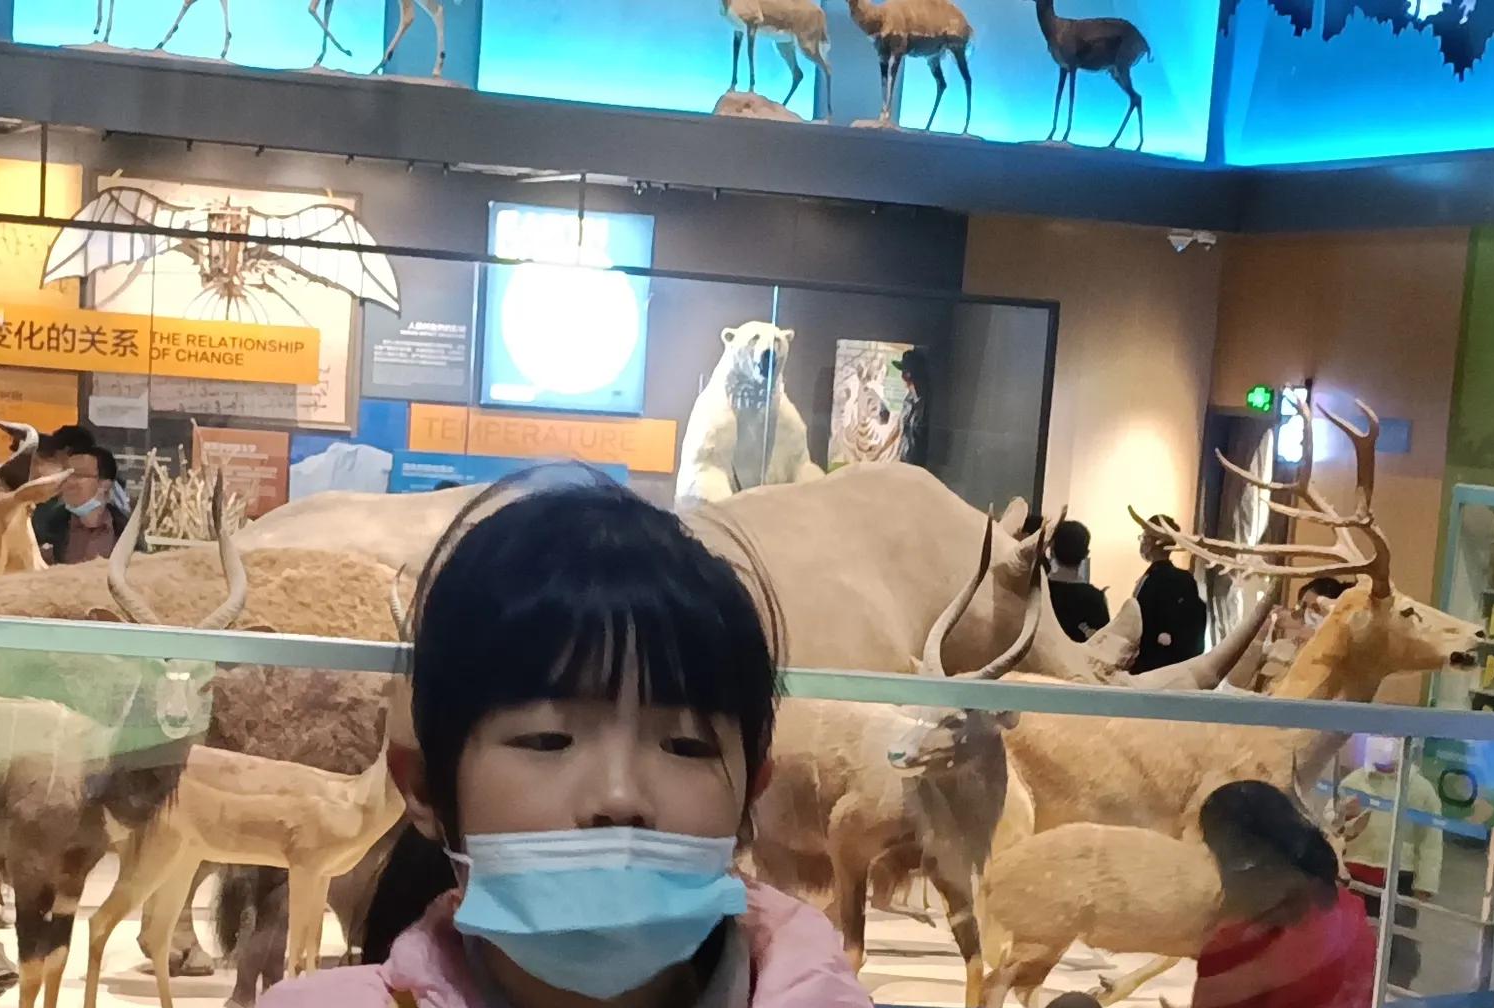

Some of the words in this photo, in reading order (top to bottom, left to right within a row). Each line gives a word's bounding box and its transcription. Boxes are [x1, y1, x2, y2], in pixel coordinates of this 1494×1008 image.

[150, 331, 181, 348] THE
[186, 334, 305, 354] RELATIONSHIP
[149, 347, 168, 362] OF
[175, 350, 245, 366] CHANGE
[423, 416, 637, 452] TEMPERATURE
